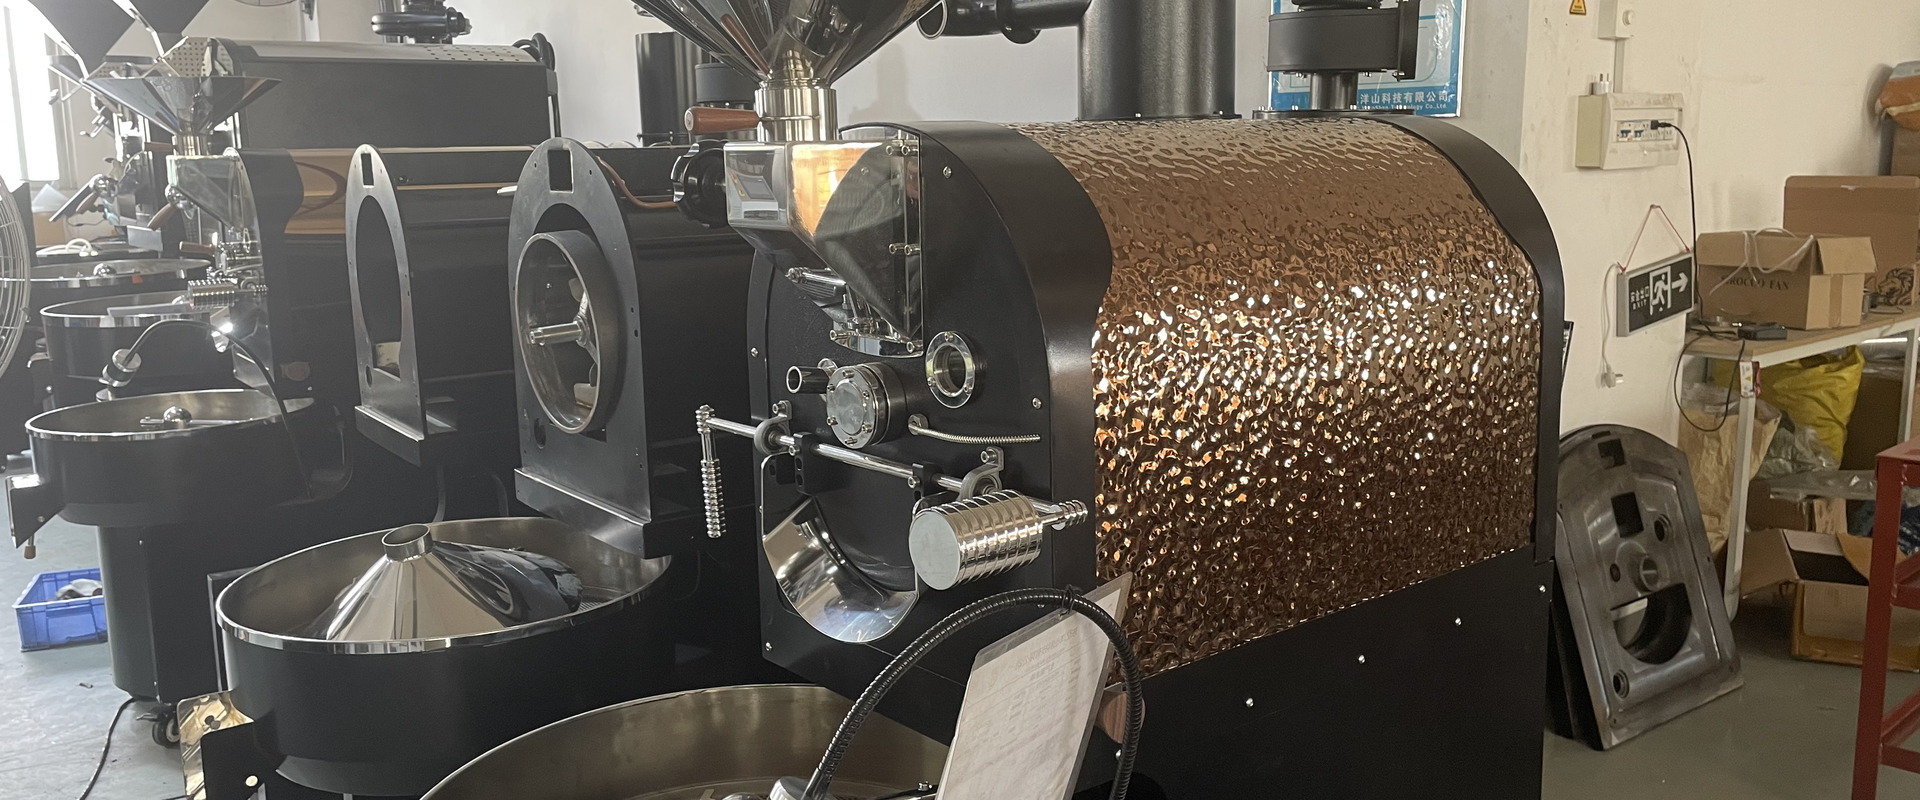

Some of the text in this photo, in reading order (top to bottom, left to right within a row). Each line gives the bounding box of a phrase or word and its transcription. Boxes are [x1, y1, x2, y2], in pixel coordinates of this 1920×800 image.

[1357, 90, 1448, 104] 洋山科技有限公司
[1769, 279, 1790, 291] FAN
